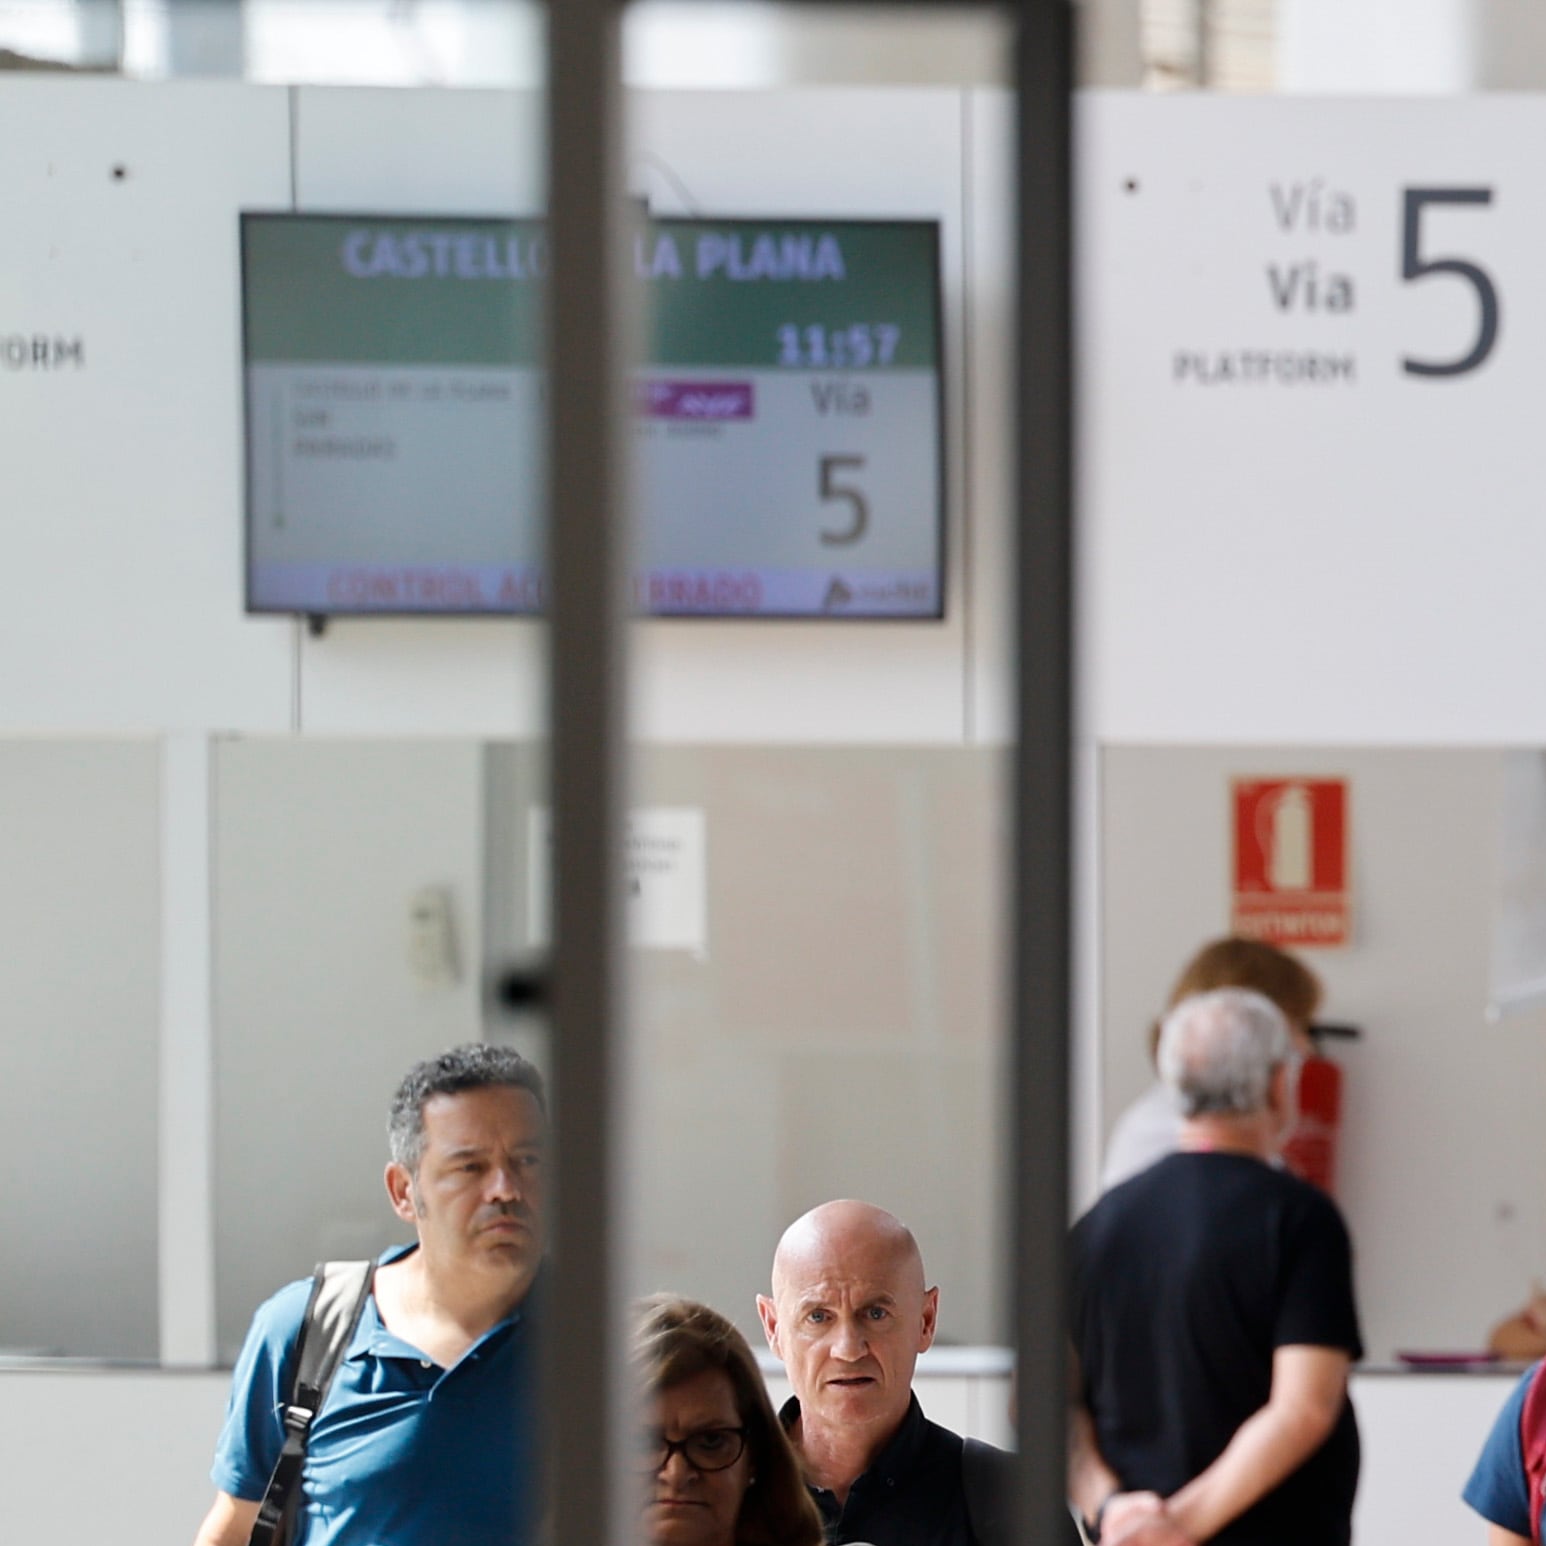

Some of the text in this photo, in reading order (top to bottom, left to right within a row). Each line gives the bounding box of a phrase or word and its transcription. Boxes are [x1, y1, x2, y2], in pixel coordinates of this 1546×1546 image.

[1269, 177, 1356, 233] Vía
[696, 233, 846, 281] PLANA
[1402, 187, 1500, 378] 5
[0, 333, 87, 372] ORM
[776, 322, 899, 368] 11:57
[1173, 349, 1357, 384] PLATFORM
[817, 453, 870, 548] 5
